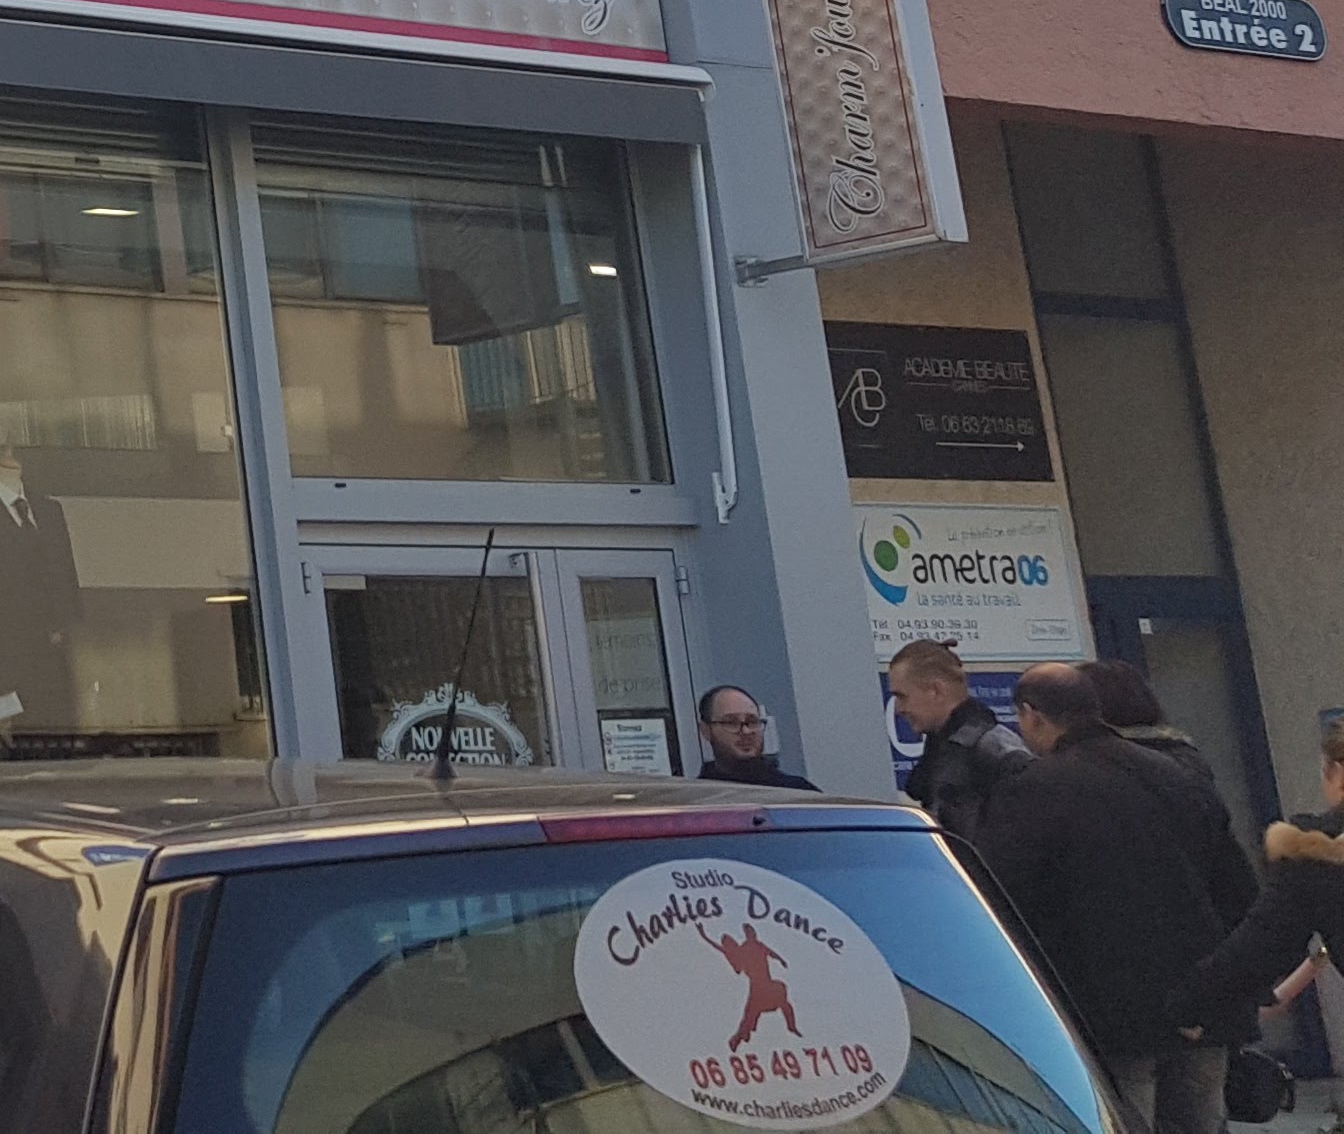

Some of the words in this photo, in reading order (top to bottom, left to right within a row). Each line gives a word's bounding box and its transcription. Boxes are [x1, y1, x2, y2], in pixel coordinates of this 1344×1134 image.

[1180, 8, 1289, 50] Entrée
[1293, 23, 1317, 53] 2
[917, 591, 929, 606] La
[965, 594, 981, 606] au
[982, 592, 1022, 607] travail
[671, 869, 734, 890] Studio
[607, 893, 724, 966] Charlies
[733, 885, 844, 955] Dance
[688, 1056, 727, 1090] 06
[729, 1053, 765, 1085] 85
[770, 1049, 802, 1080] 49
[802, 1046, 839, 1077] 71
[840, 1044, 874, 1075] 09
[690, 1071, 888, 1119] www.charliesdance.com
